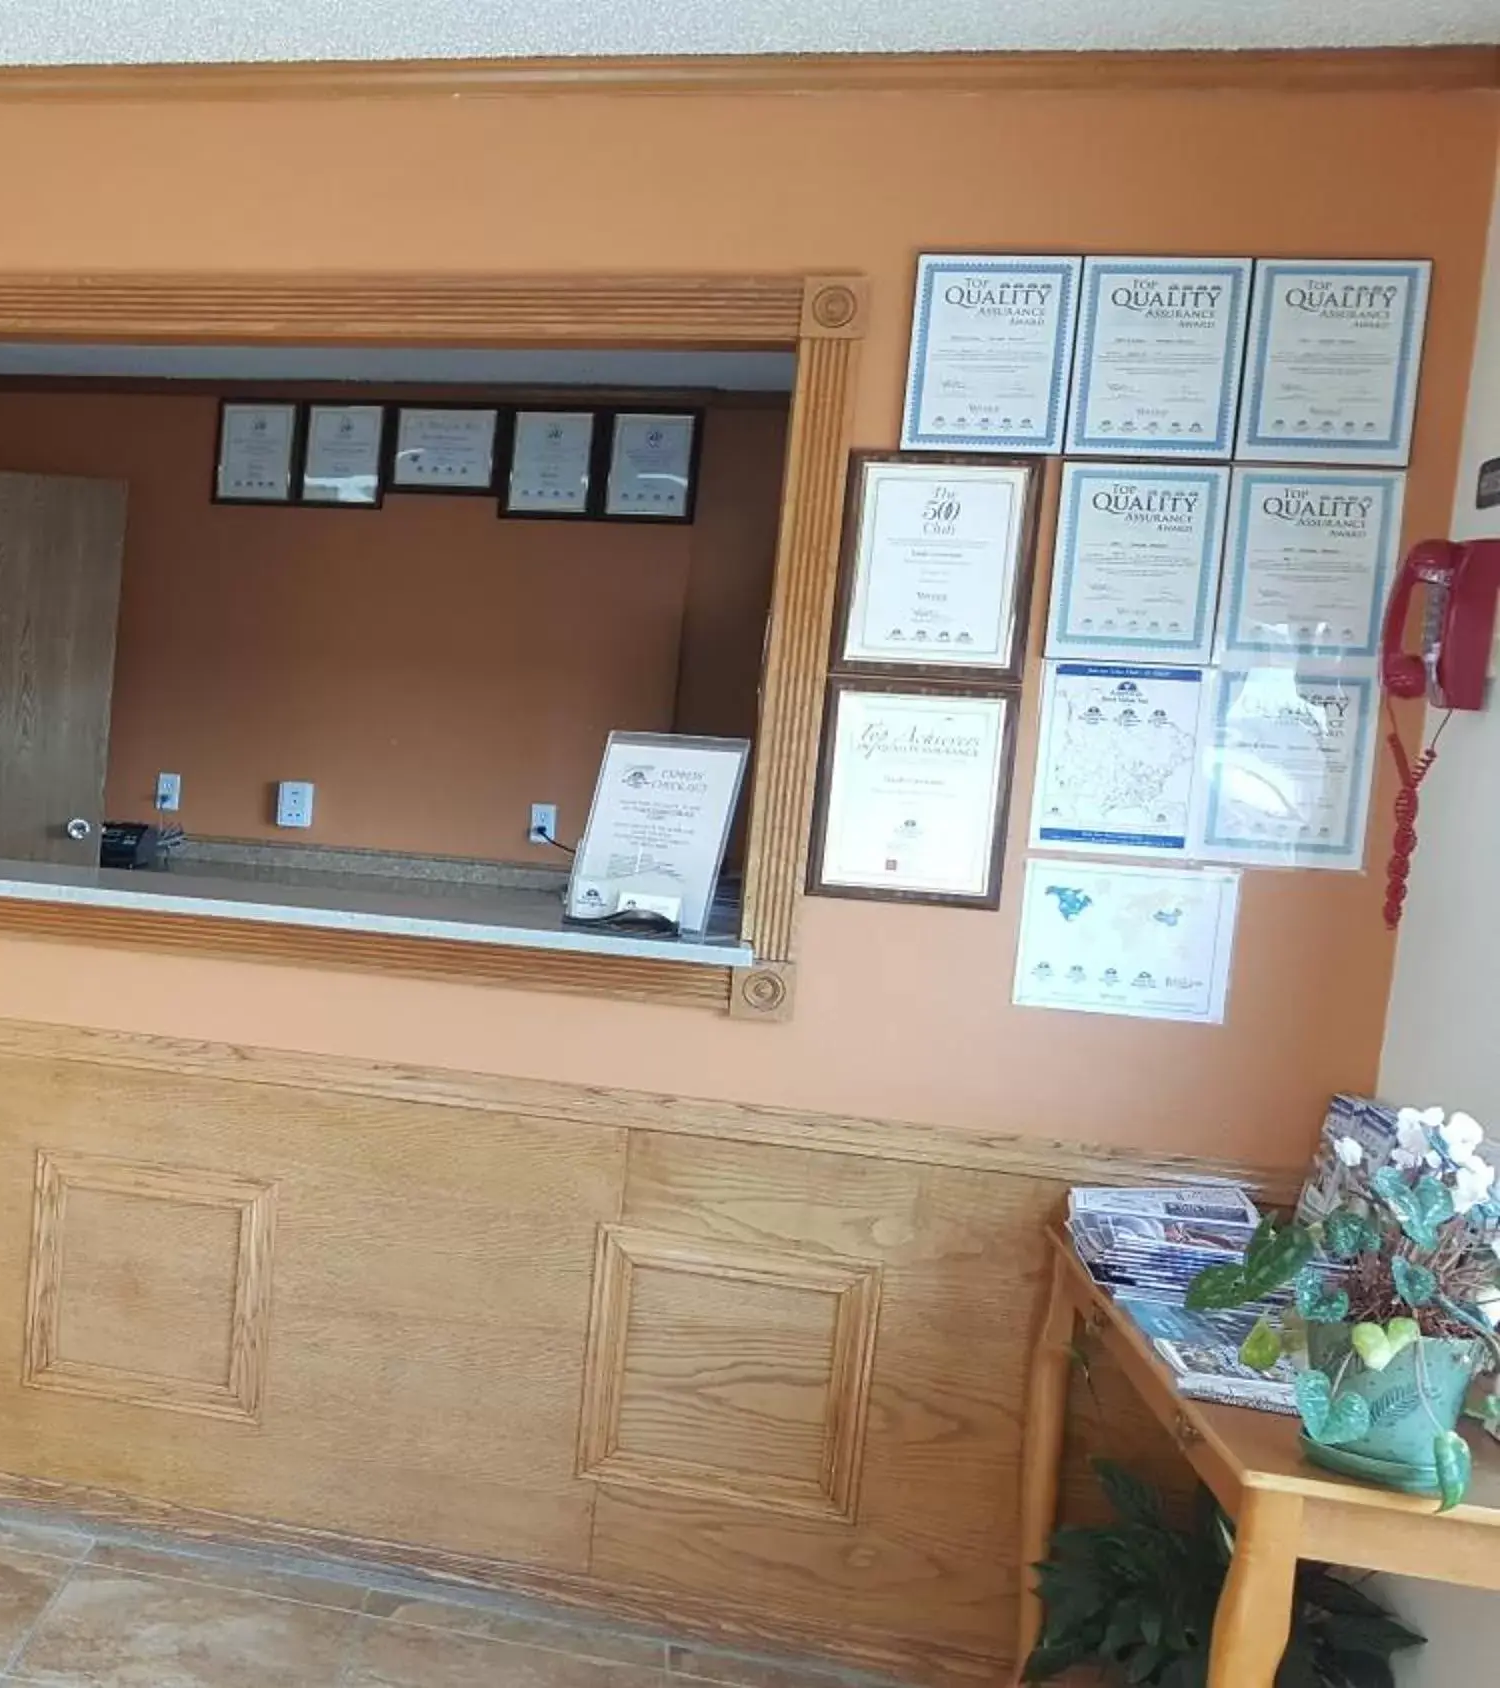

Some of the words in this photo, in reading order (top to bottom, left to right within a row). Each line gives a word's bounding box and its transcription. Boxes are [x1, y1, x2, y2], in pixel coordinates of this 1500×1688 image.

[945, 284, 1052, 309] QUALITY
[1111, 287, 1221, 312] QUALITY
[1285, 287, 1398, 313] QUALITY
[1112, 484, 1138, 494] TOP
[1283, 488, 1309, 498] TOP
[1092, 492, 1199, 516] QUALITY
[1262, 496, 1371, 521] QUALITY
[1124, 512, 1193, 523] ASSURANCE
[1296, 517, 1367, 528] ASSURANCE
